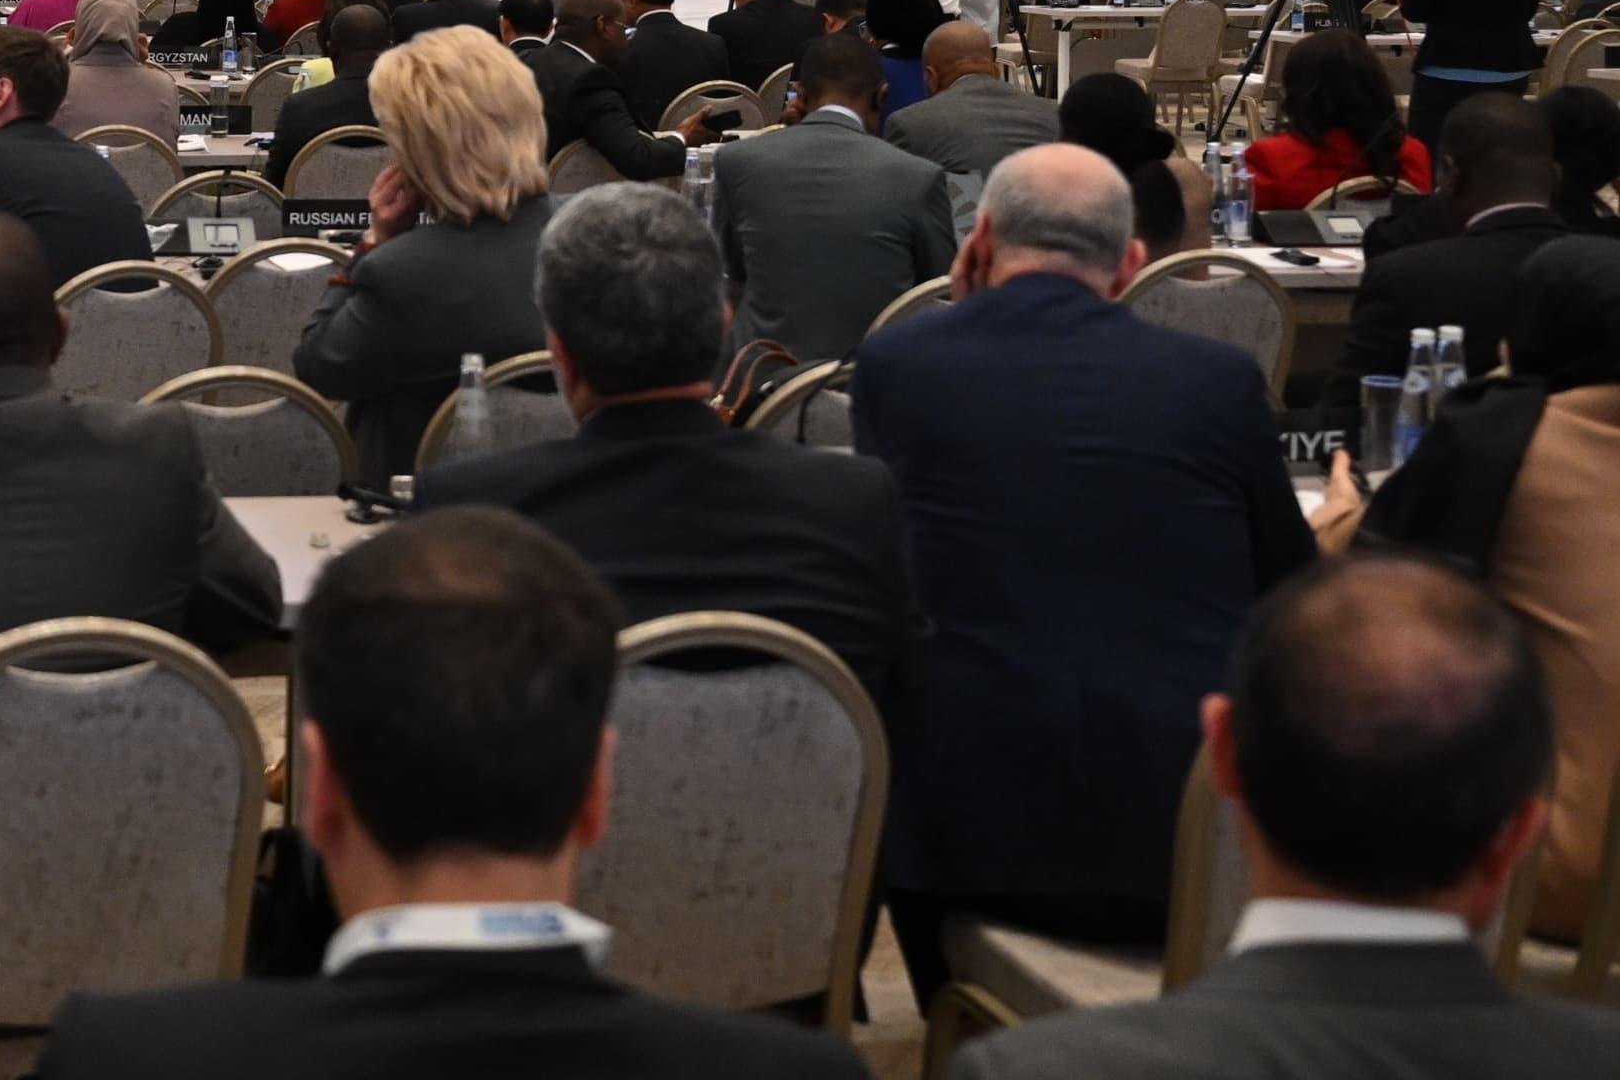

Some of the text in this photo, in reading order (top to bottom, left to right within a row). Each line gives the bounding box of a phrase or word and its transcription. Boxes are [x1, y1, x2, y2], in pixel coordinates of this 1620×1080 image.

[148, 52, 208, 62] RGYZSTAN
[180, 114, 211, 125] MAN
[289, 212, 354, 225] RUSSIAN
